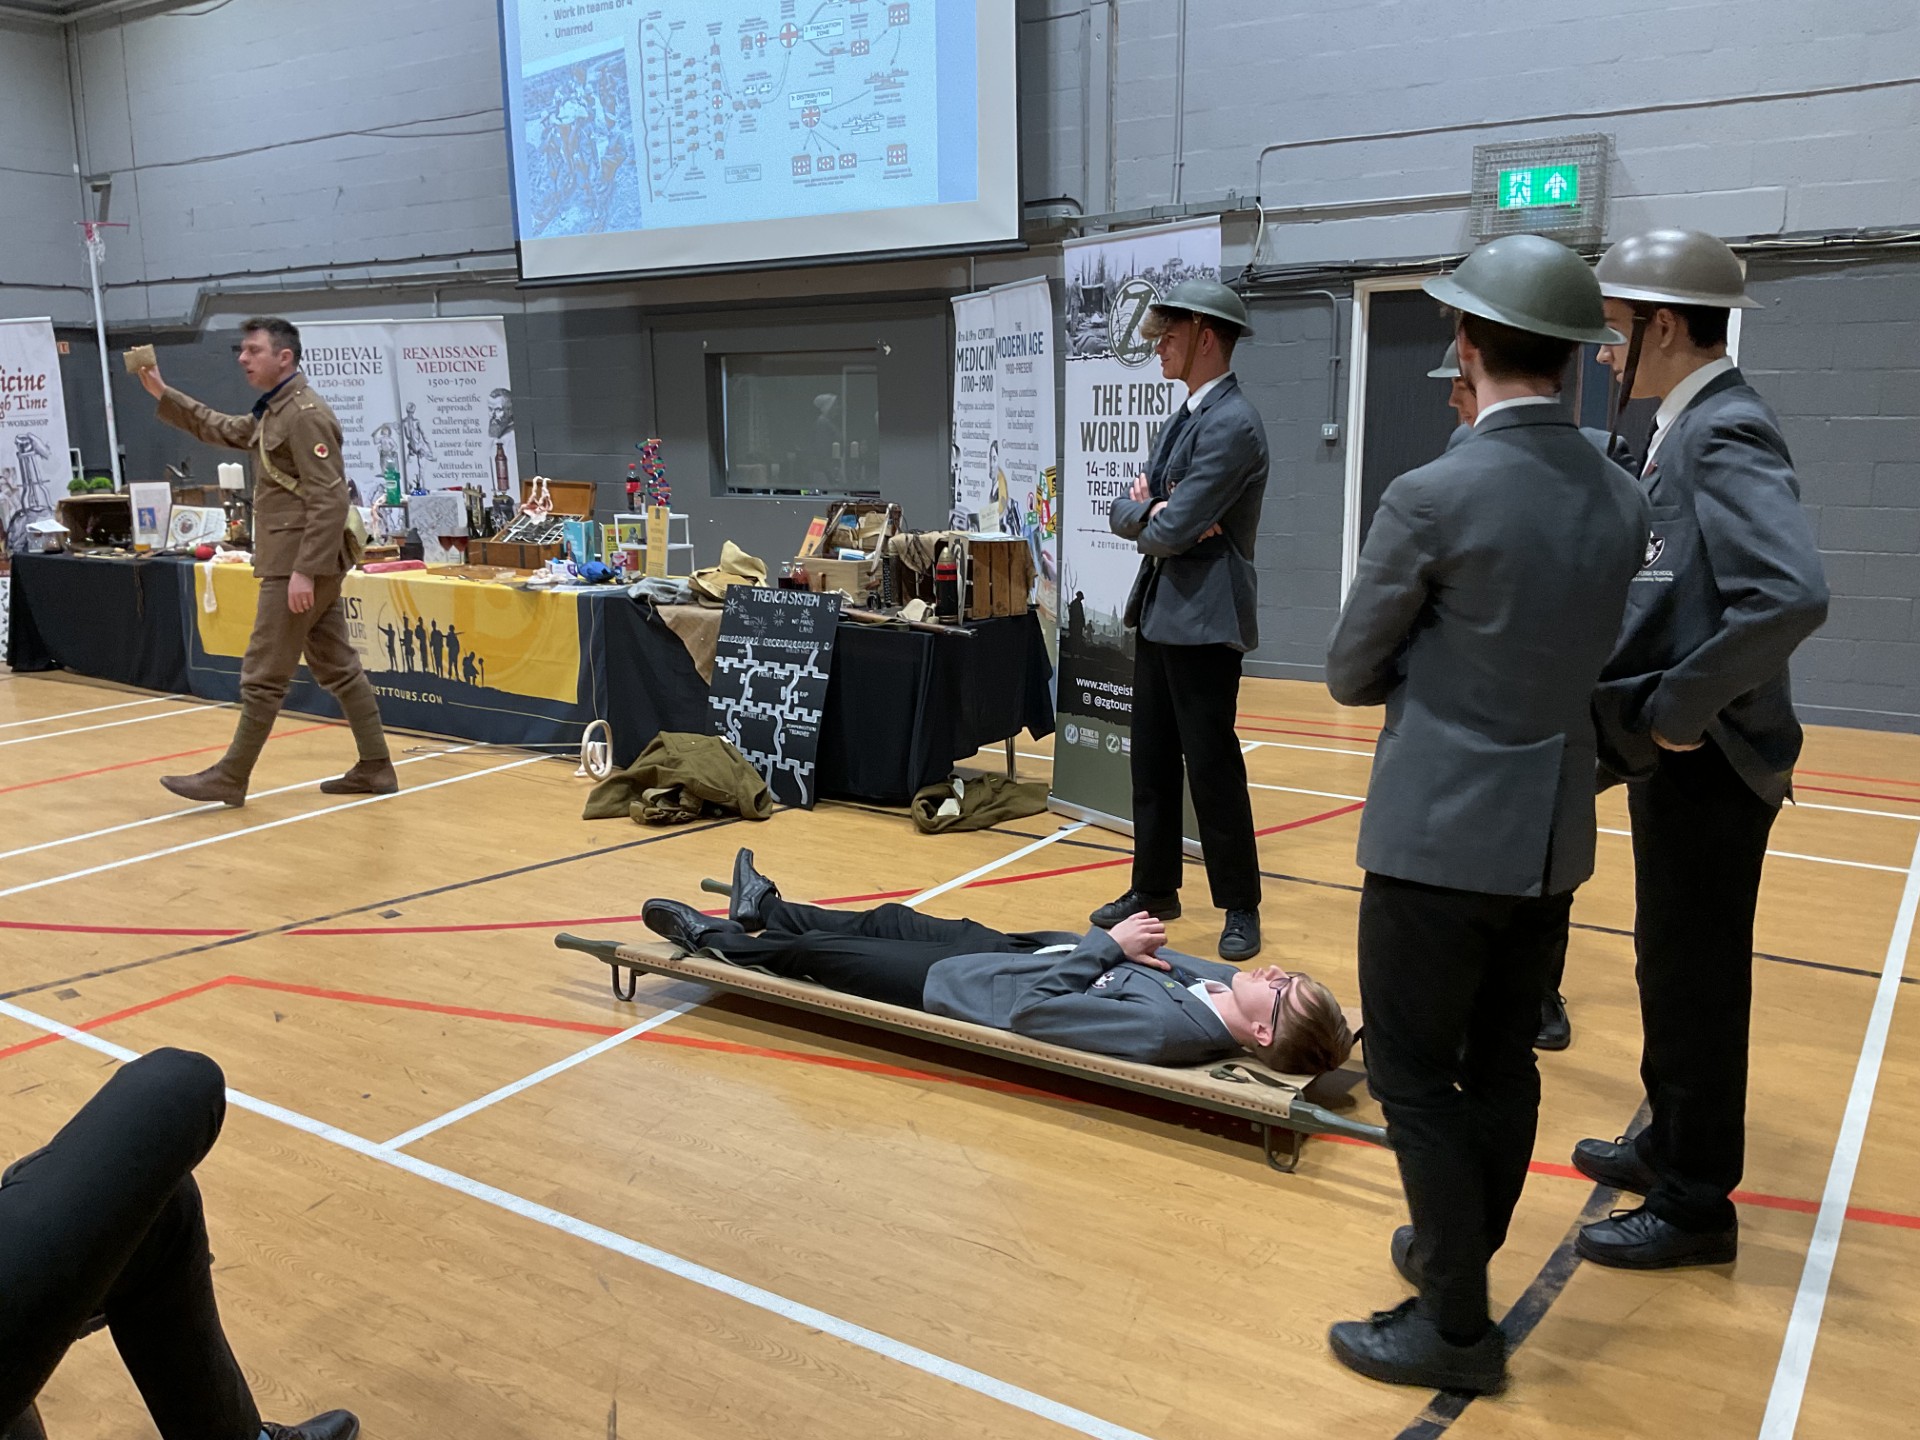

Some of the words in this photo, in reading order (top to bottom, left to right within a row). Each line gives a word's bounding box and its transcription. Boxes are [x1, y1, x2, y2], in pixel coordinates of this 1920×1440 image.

[554, 7, 575, 21] Work
[587, 1, 614, 13] teams
[555, 21, 593, 39] Unarmed
[810, 21, 842, 32] EVACUATION
[816, 29, 830, 37] ZONE
[797, 90, 830, 101] DISTRIBUTION
[996, 334, 1027, 359] MODERN
[1028, 332, 1044, 355] AGE
[300, 346, 383, 362] MEDIEVAL
[403, 345, 498, 360] RENAISSANCE
[956, 345, 997, 372] MEDICIN
[416, 360, 486, 374] MEDICINE
[0, 366, 46, 392] icine
[317, 379, 365, 388] 1250-1500
[428, 378, 477, 388] 1500-1700
[13, 394, 48, 410] Time
[427, 395, 445, 403] New
[446, 394, 480, 403] scientific
[1092, 384, 1123, 416] THE
[1128, 382, 1174, 416] FIRST
[331, 402, 363, 410] tandstill
[437, 403, 472, 413] approach
[7, 419, 49, 428] WORKSHOP
[355, 416, 363, 424] of
[432, 417, 480, 428] Challenging
[341, 424, 364, 433] hurch
[432, 427, 460, 435] ancient
[462, 426, 482, 434] ideas
[1012, 420, 1034, 433] technology
[962, 430, 990, 442] understanding
[1080, 421, 1139, 453] WORLD
[1002, 439, 1026, 450] Government
[1027, 442, 1039, 451] action
[963, 447, 987, 458] Government
[345, 460, 374, 470] tanding
[437, 462, 474, 470] Attitudes
[476, 462, 483, 470] in
[1005, 459, 1037, 474] Groundbreaking
[432, 471, 459, 480] society
[461, 470, 489, 479] remain
[1091, 500, 1111, 516] THE
[1097, 541, 1129, 550] ZEITGEIST
[752, 588, 788, 604] TRENCH
[788, 590, 820, 607] SYSTEM
[799, 626, 814, 634] LAND
[1094, 696, 1132, 713] @zgtours
